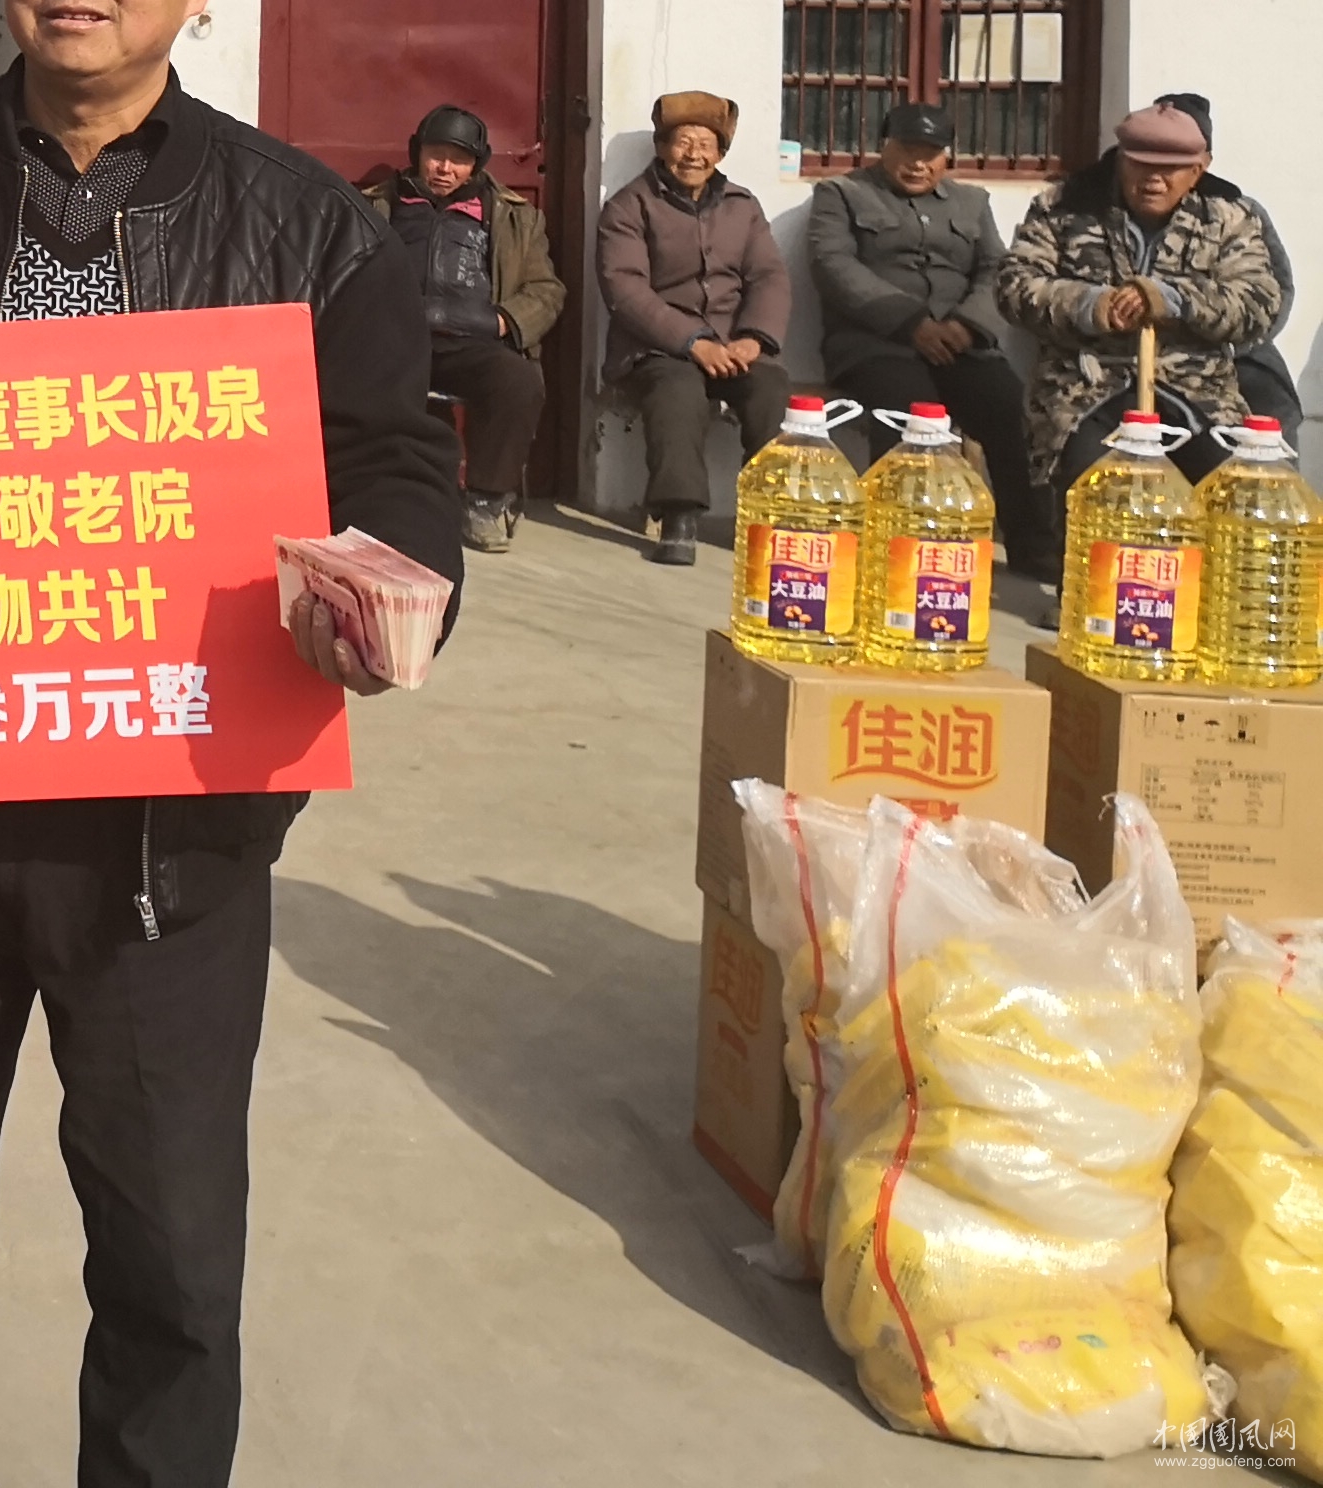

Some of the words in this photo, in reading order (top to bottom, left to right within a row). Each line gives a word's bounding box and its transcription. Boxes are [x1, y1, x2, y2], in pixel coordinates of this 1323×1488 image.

[770, 533, 833, 565] 佳润
[916, 544, 975, 574] 佳润
[1117, 550, 1180, 581] 佳润
[770, 578, 827, 602] 大豆油
[916, 590, 970, 611] 大豆油
[1117, 596, 1174, 620] 大豆油
[841, 699, 994, 778] 佳润
